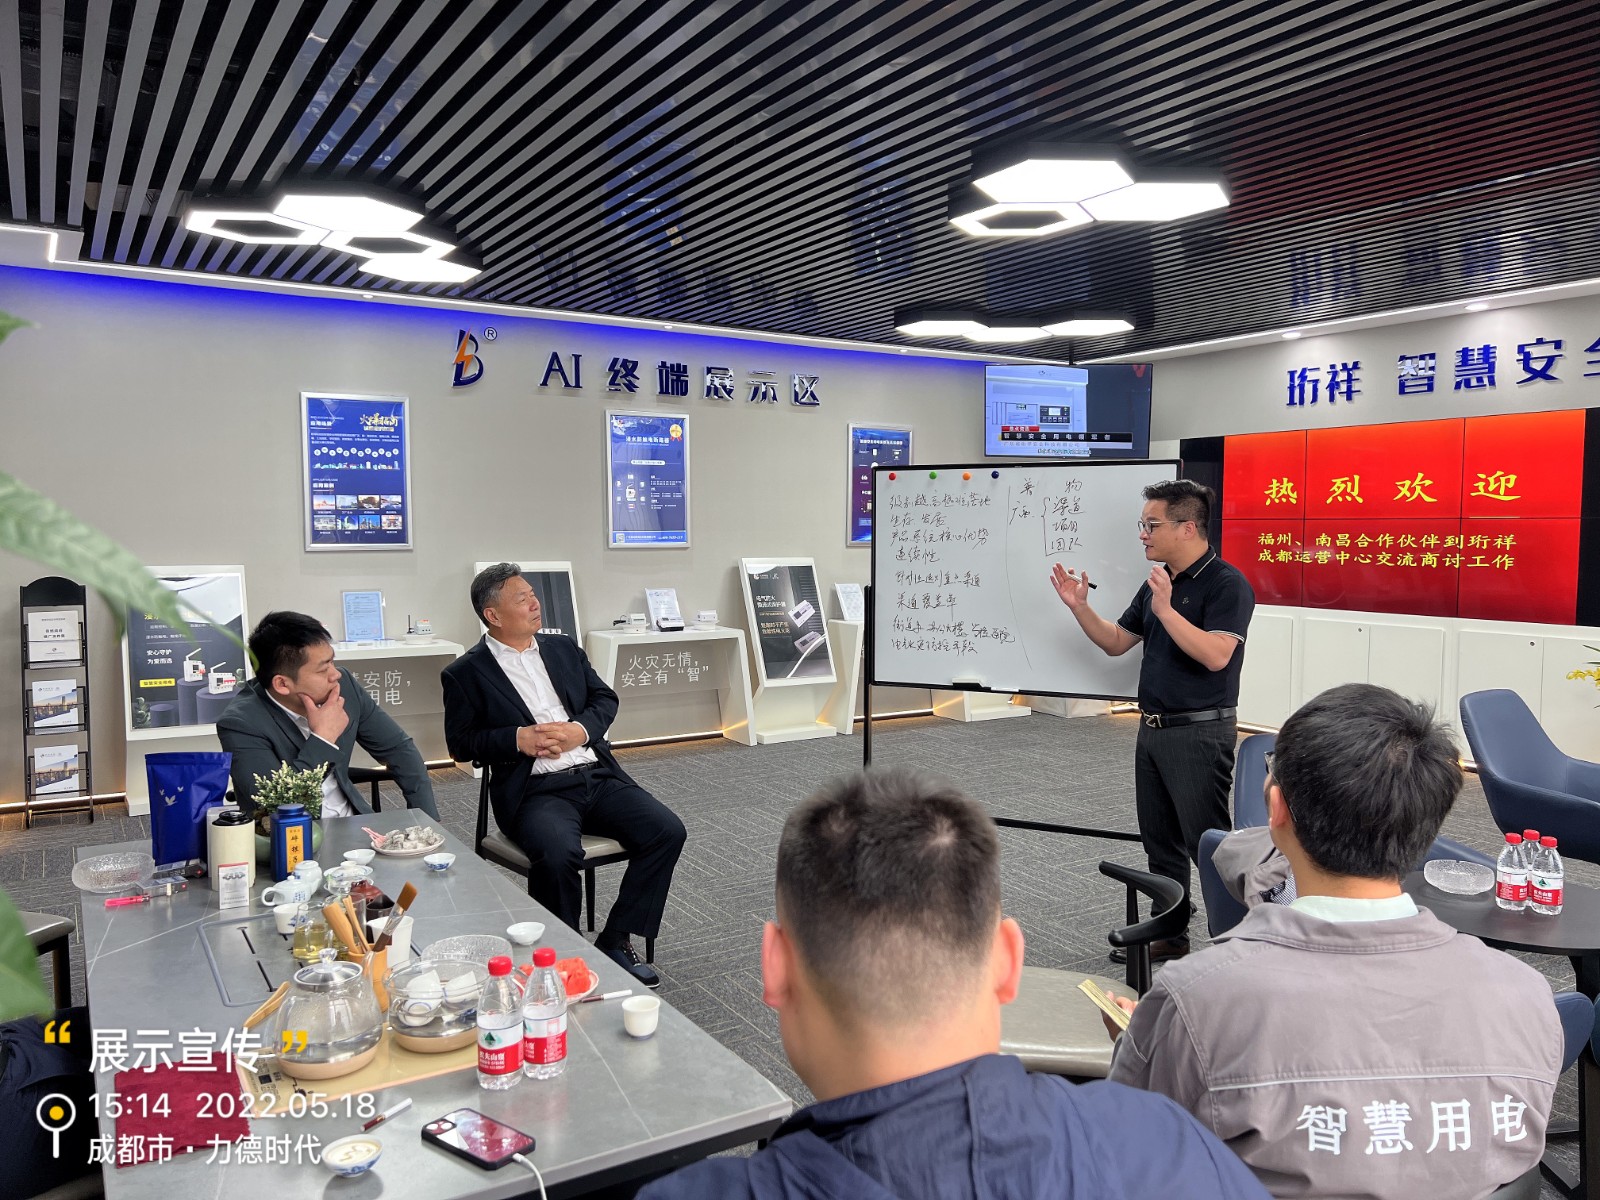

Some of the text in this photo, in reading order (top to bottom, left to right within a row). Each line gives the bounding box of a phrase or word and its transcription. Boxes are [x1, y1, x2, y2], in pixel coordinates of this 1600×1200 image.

[1286, 360, 1362, 408] 珩祥
[1264, 470, 1521, 506] 热烈欢迎
[1257, 532, 1518, 551] 福州、南昌合作伙伴到珩祥
[1257, 549, 1515, 570] 成都运营中心交流商讨工作
[1295, 1094, 1529, 1156] 智慧用电
